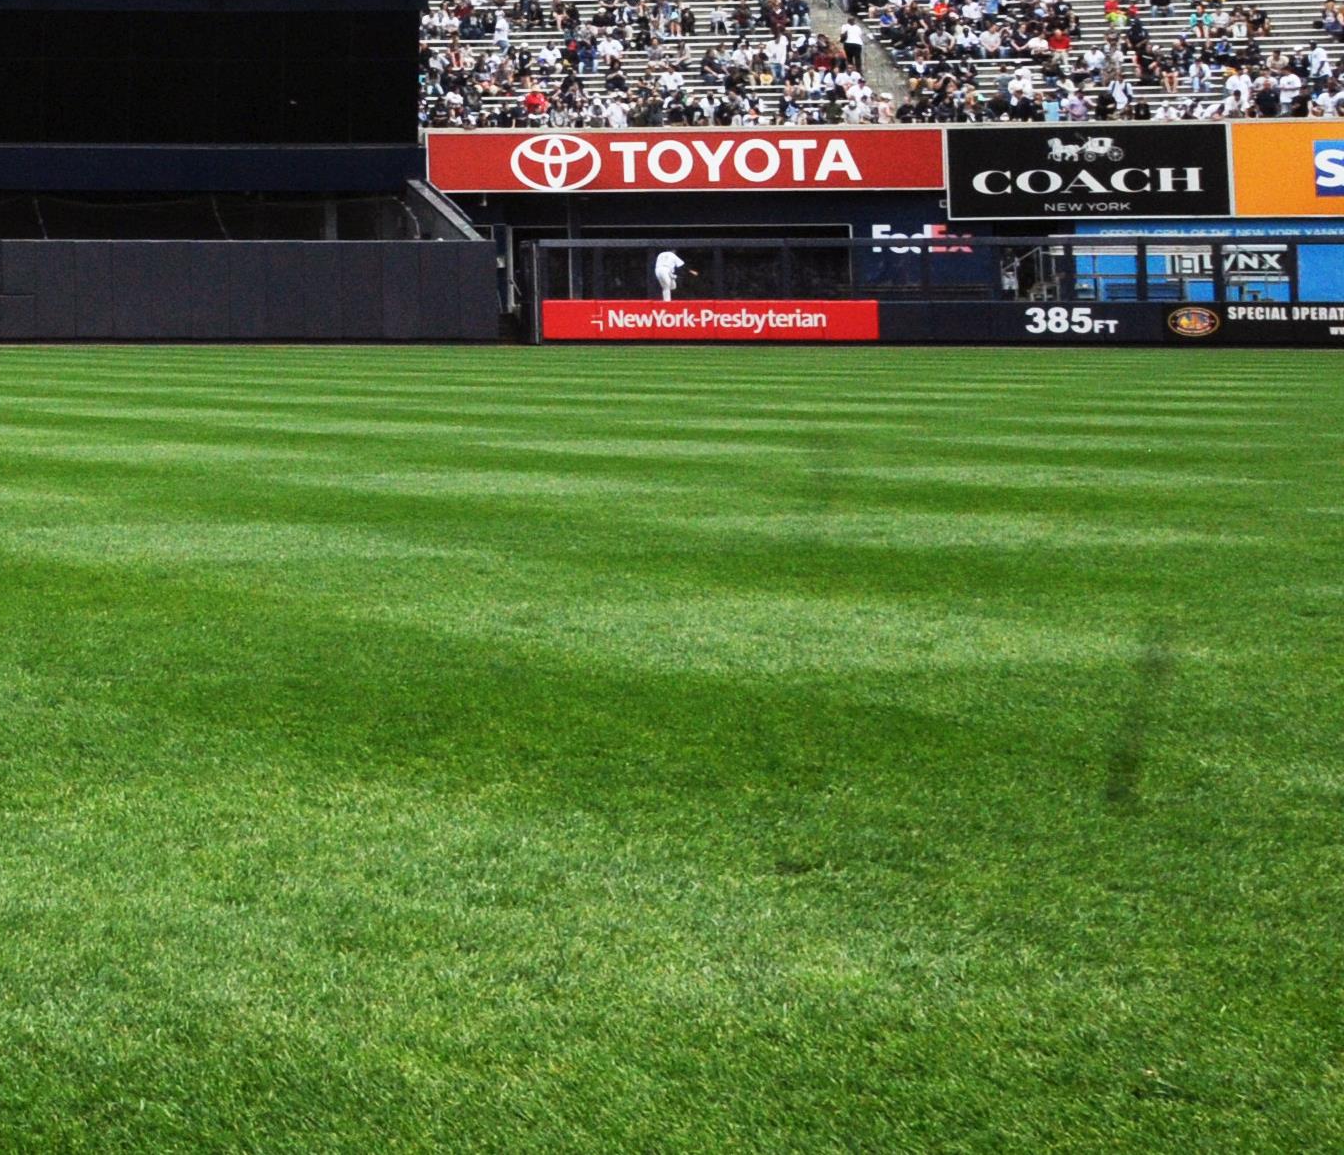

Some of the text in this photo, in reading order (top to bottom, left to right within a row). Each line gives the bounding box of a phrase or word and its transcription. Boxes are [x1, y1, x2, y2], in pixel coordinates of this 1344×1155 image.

[609, 138, 863, 184] TOYOTA
[971, 166, 1204, 196] COACH
[1043, 201, 1132, 213] NEW YORK
[1227, 306, 1289, 320] SPECIAL
